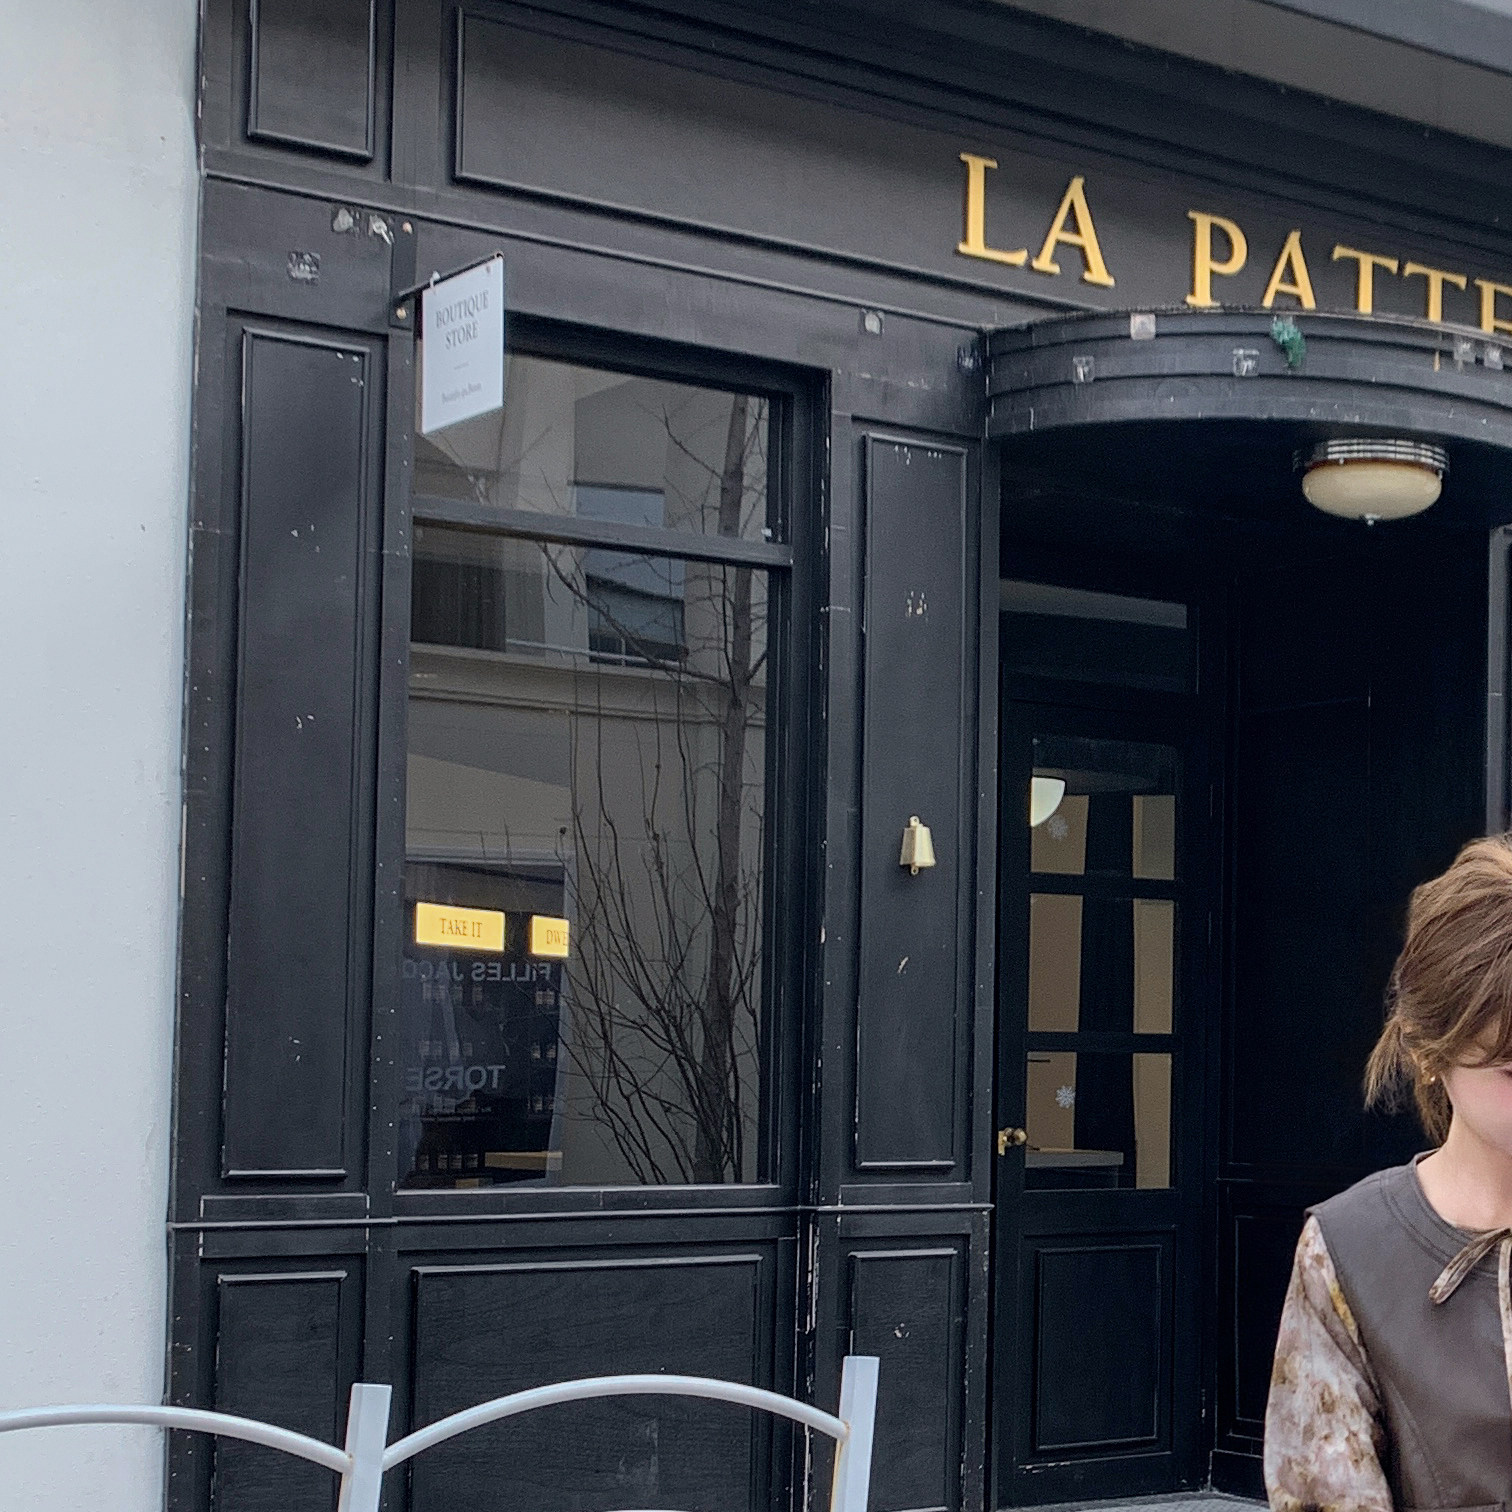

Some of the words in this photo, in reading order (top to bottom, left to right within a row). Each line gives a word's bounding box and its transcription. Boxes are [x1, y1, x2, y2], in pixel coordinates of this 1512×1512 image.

[958, 153, 1115, 287] LA
[436, 291, 489, 328] BOUTIQUE
[446, 322, 479, 350] STORE
[440, 917, 467, 936] TAKE
[471, 921, 483, 939] IT
